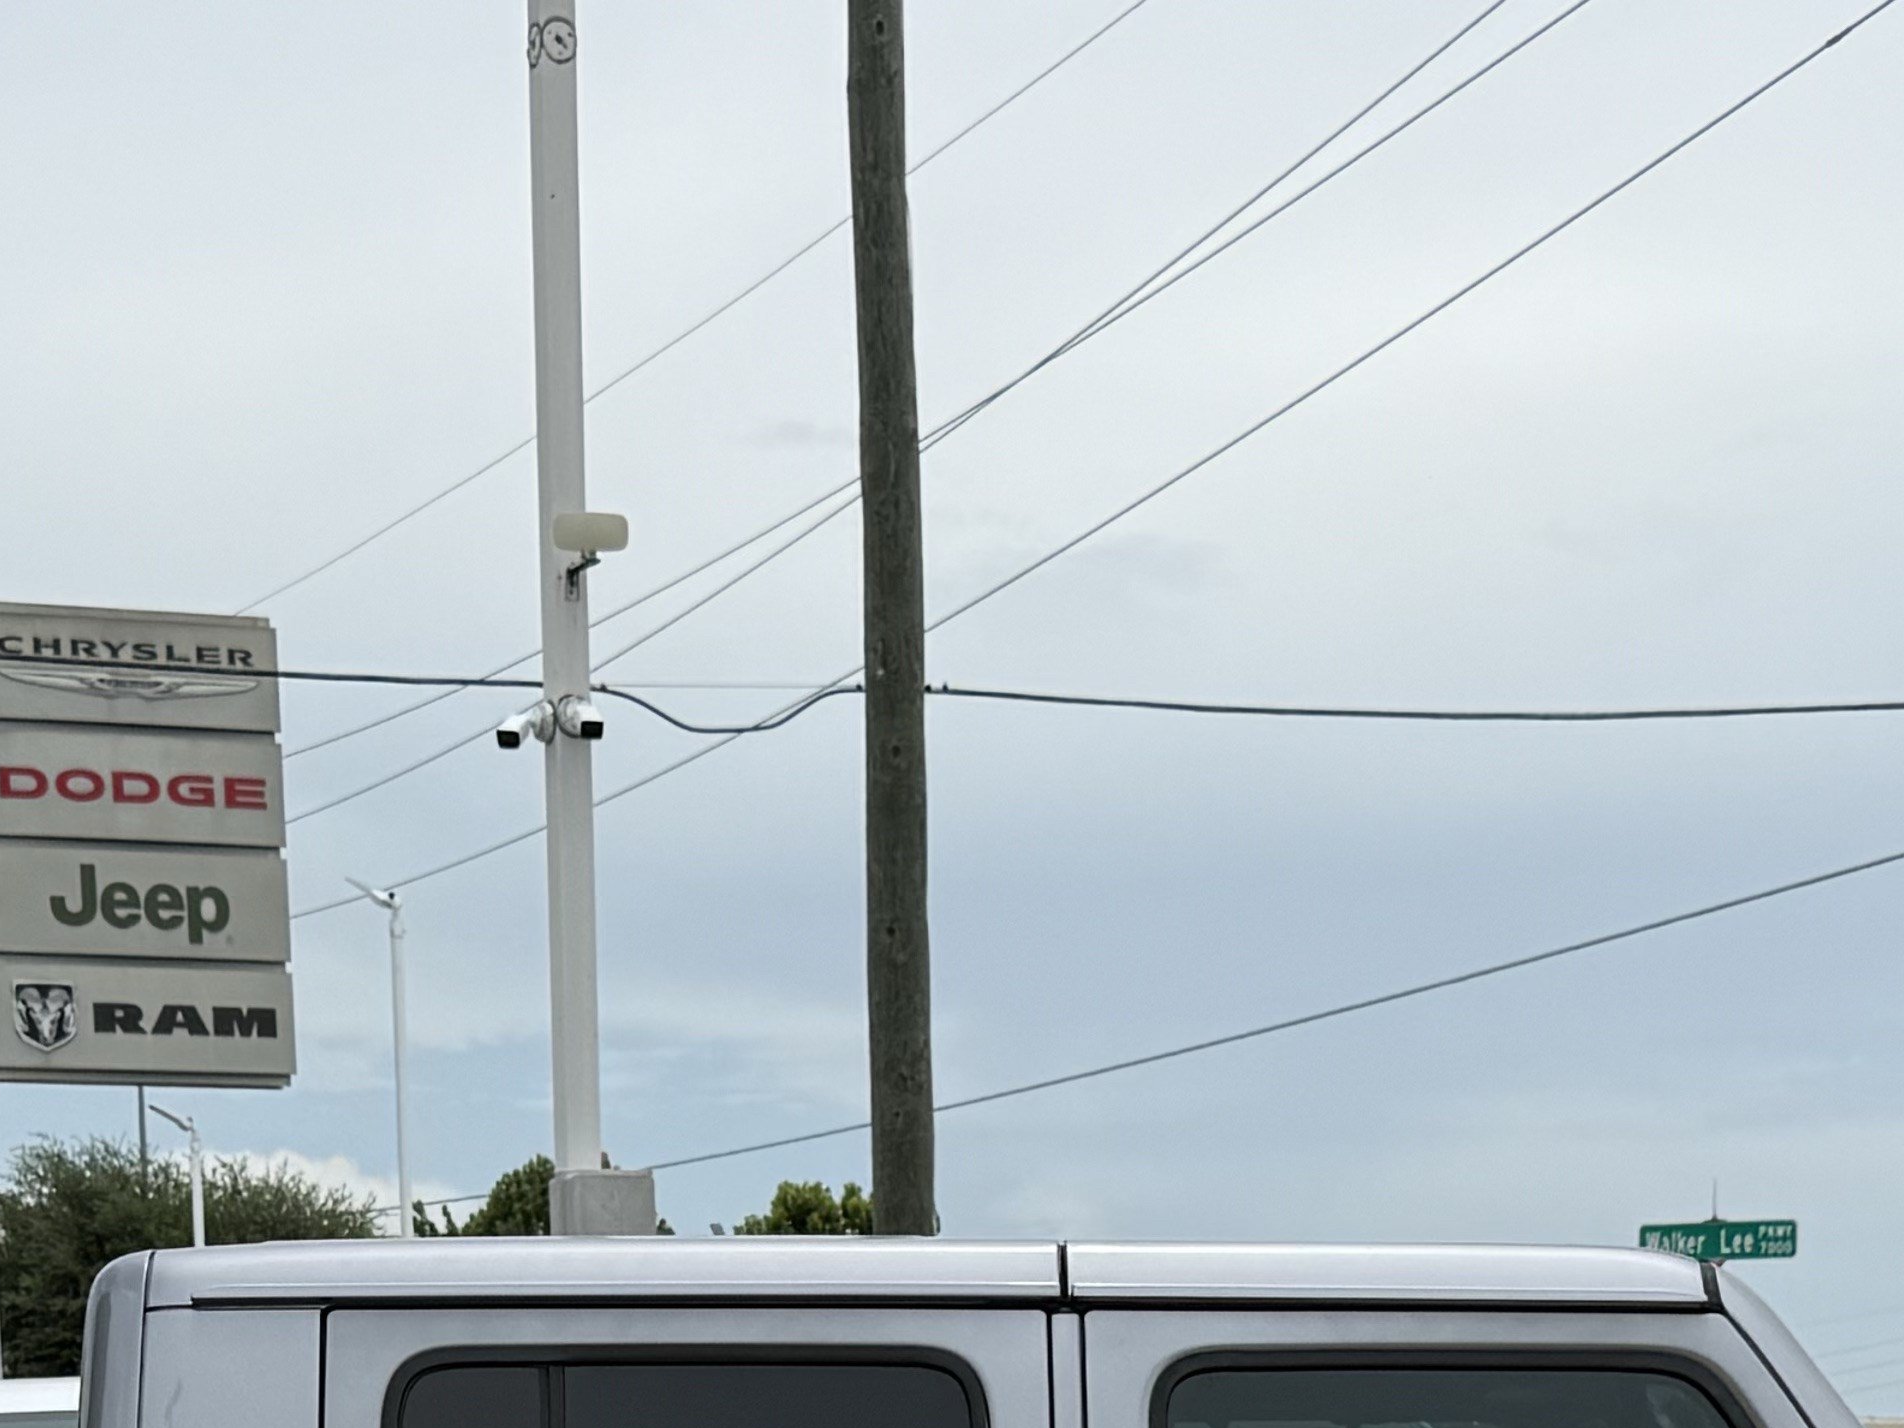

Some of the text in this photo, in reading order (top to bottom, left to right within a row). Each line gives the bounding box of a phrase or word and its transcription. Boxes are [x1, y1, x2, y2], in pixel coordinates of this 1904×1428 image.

[49, 863, 231, 945] Jeep
[92, 1002, 279, 1039] RAM
[1647, 1228, 1755, 1254] Walker Lee
